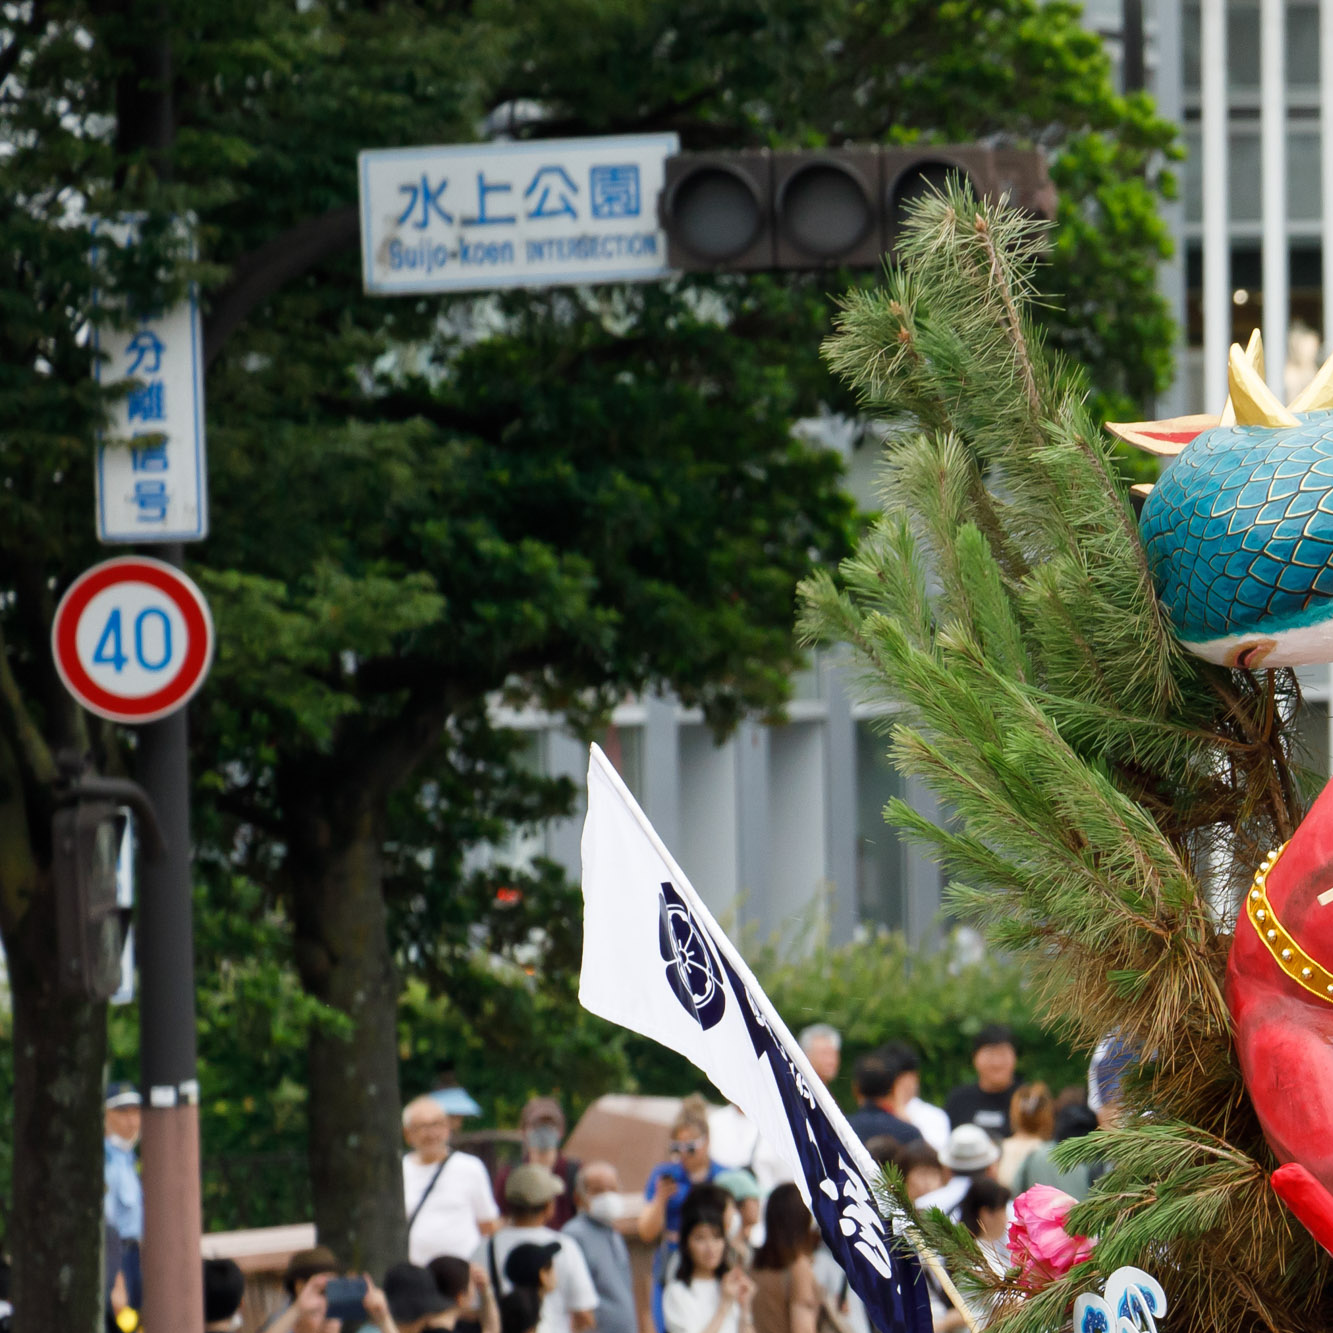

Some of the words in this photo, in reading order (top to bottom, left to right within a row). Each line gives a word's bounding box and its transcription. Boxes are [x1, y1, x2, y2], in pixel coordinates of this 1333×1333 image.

[397, 163, 641, 230] 水上公園
[389, 235, 514, 275] Suijo-koen
[525, 232, 658, 264] INTERSECTION
[93, 608, 173, 673] 40
